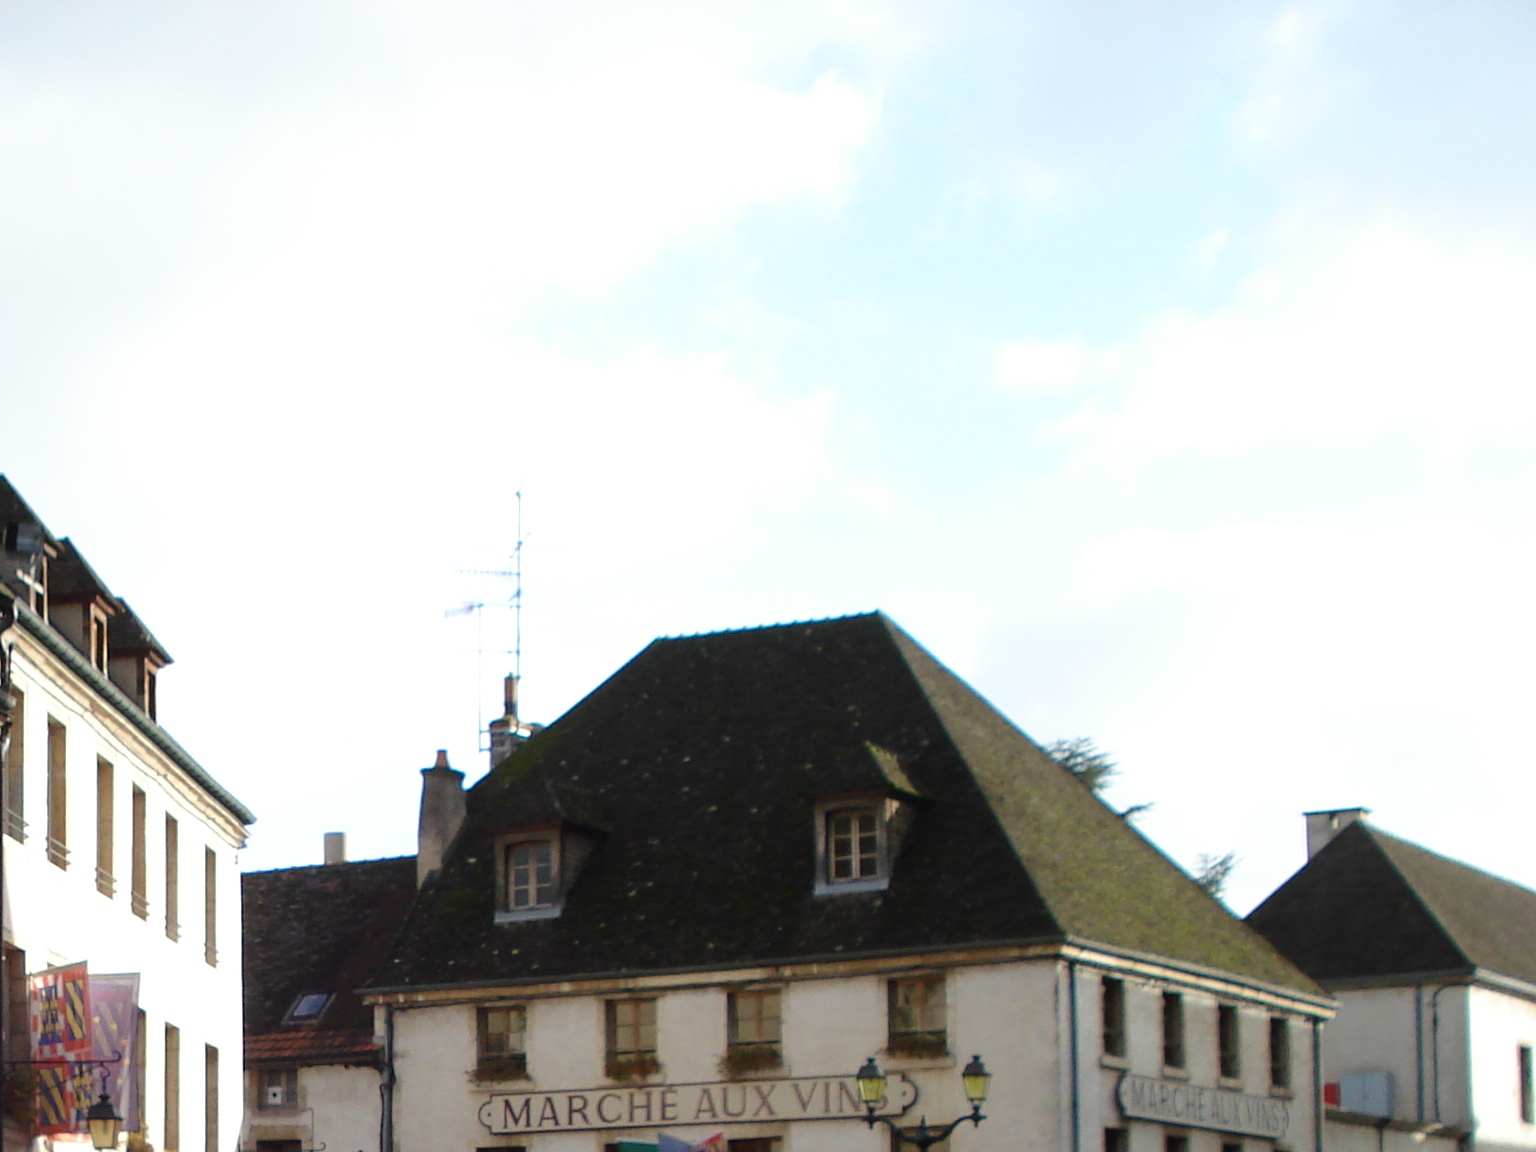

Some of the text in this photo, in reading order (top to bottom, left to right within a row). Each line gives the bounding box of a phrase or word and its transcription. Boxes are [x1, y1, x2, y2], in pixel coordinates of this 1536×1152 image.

[693, 1085, 776, 1120] AUX
[1210, 1094, 1241, 1128] AUX
[1245, 1097, 1279, 1132] VINS
